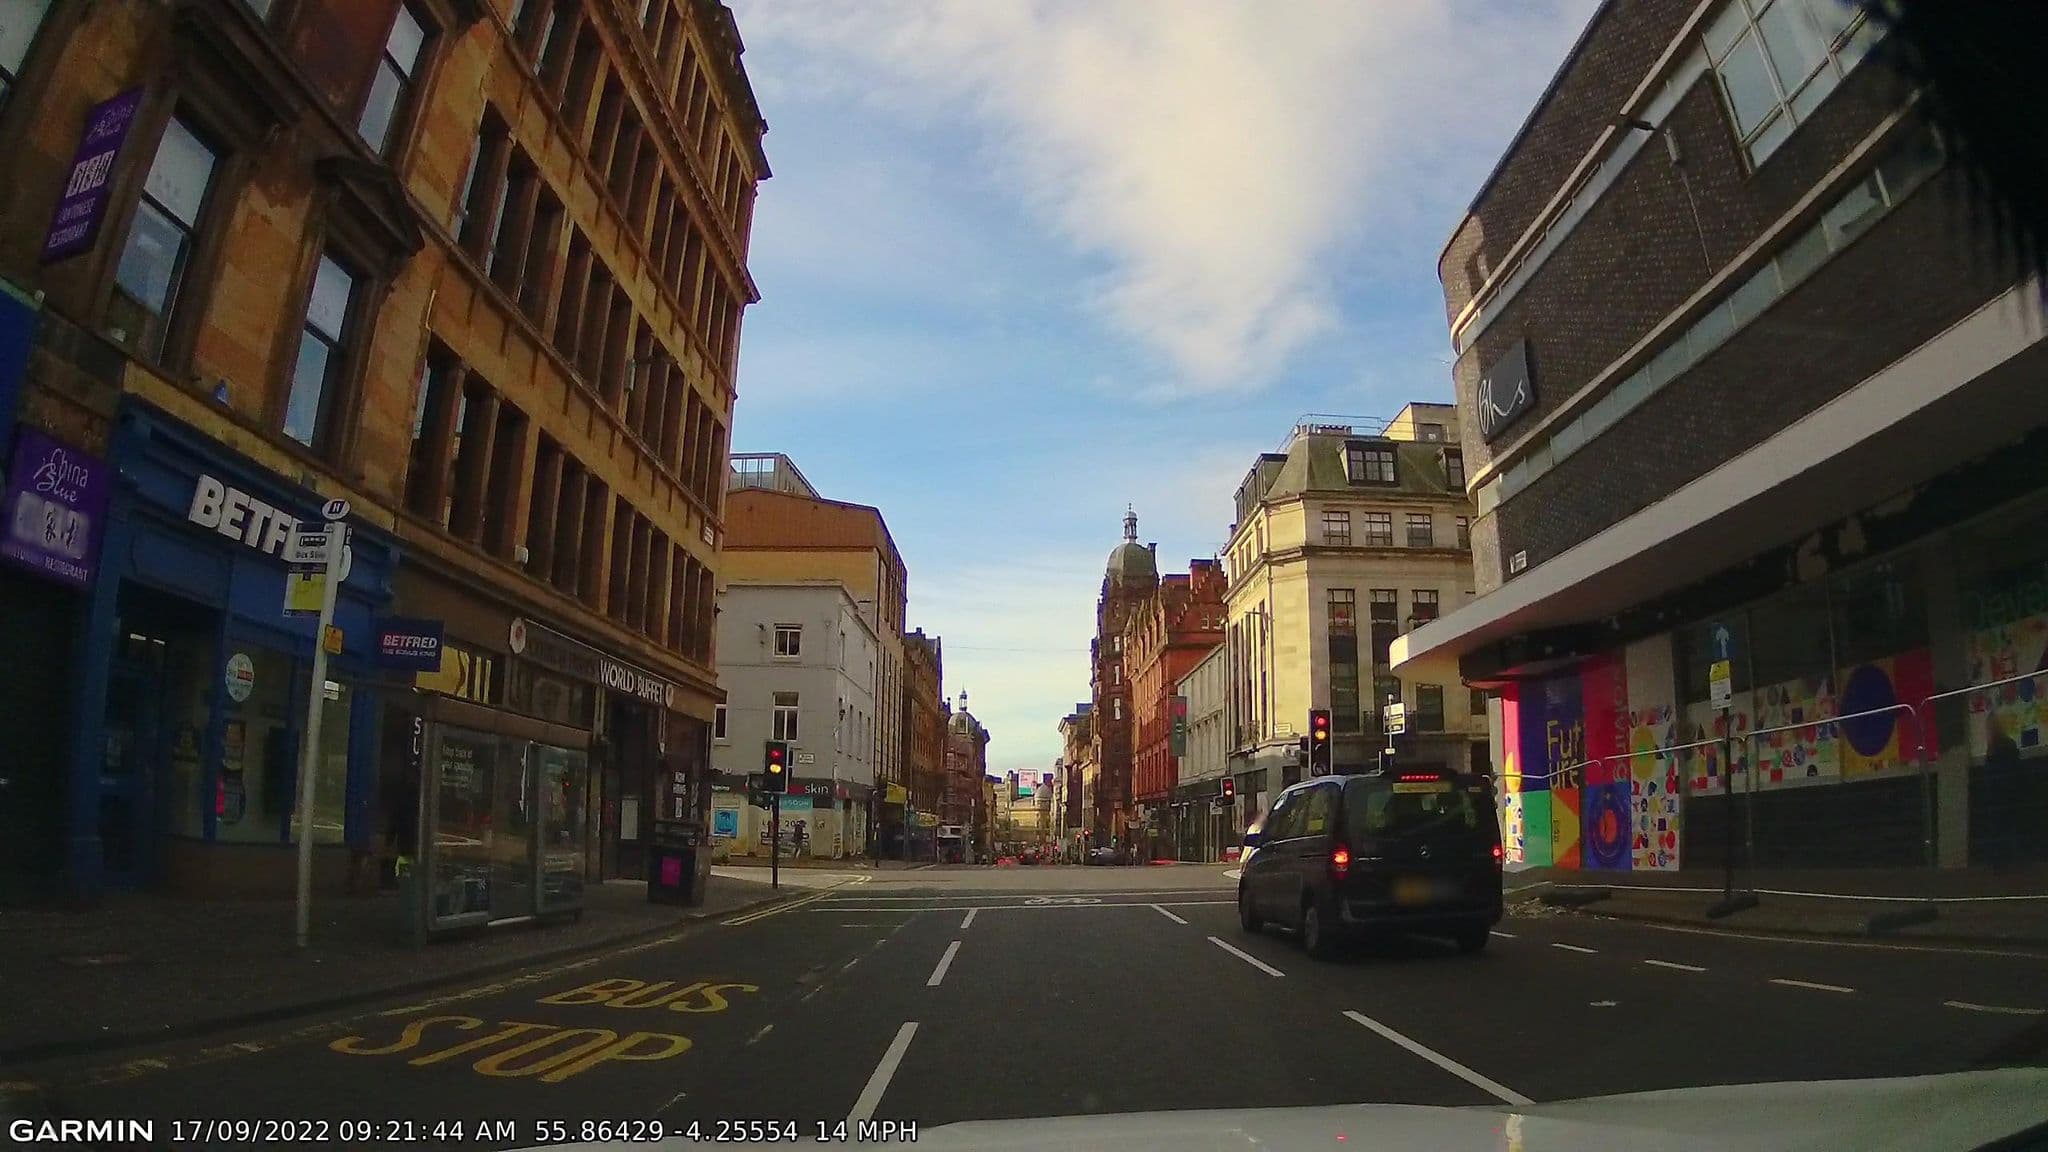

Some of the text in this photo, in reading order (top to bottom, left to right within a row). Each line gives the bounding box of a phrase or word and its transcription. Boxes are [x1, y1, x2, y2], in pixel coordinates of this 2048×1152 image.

[189, 473, 304, 563] BETF
[382, 634, 439, 649] BETFRED
[600, 658, 635, 694] WORLD
[637, 675, 664, 704] BUFFET
[804, 783, 830, 795] skin
[535, 978, 760, 1013] BUS
[328, 1015, 693, 1083] STOP
